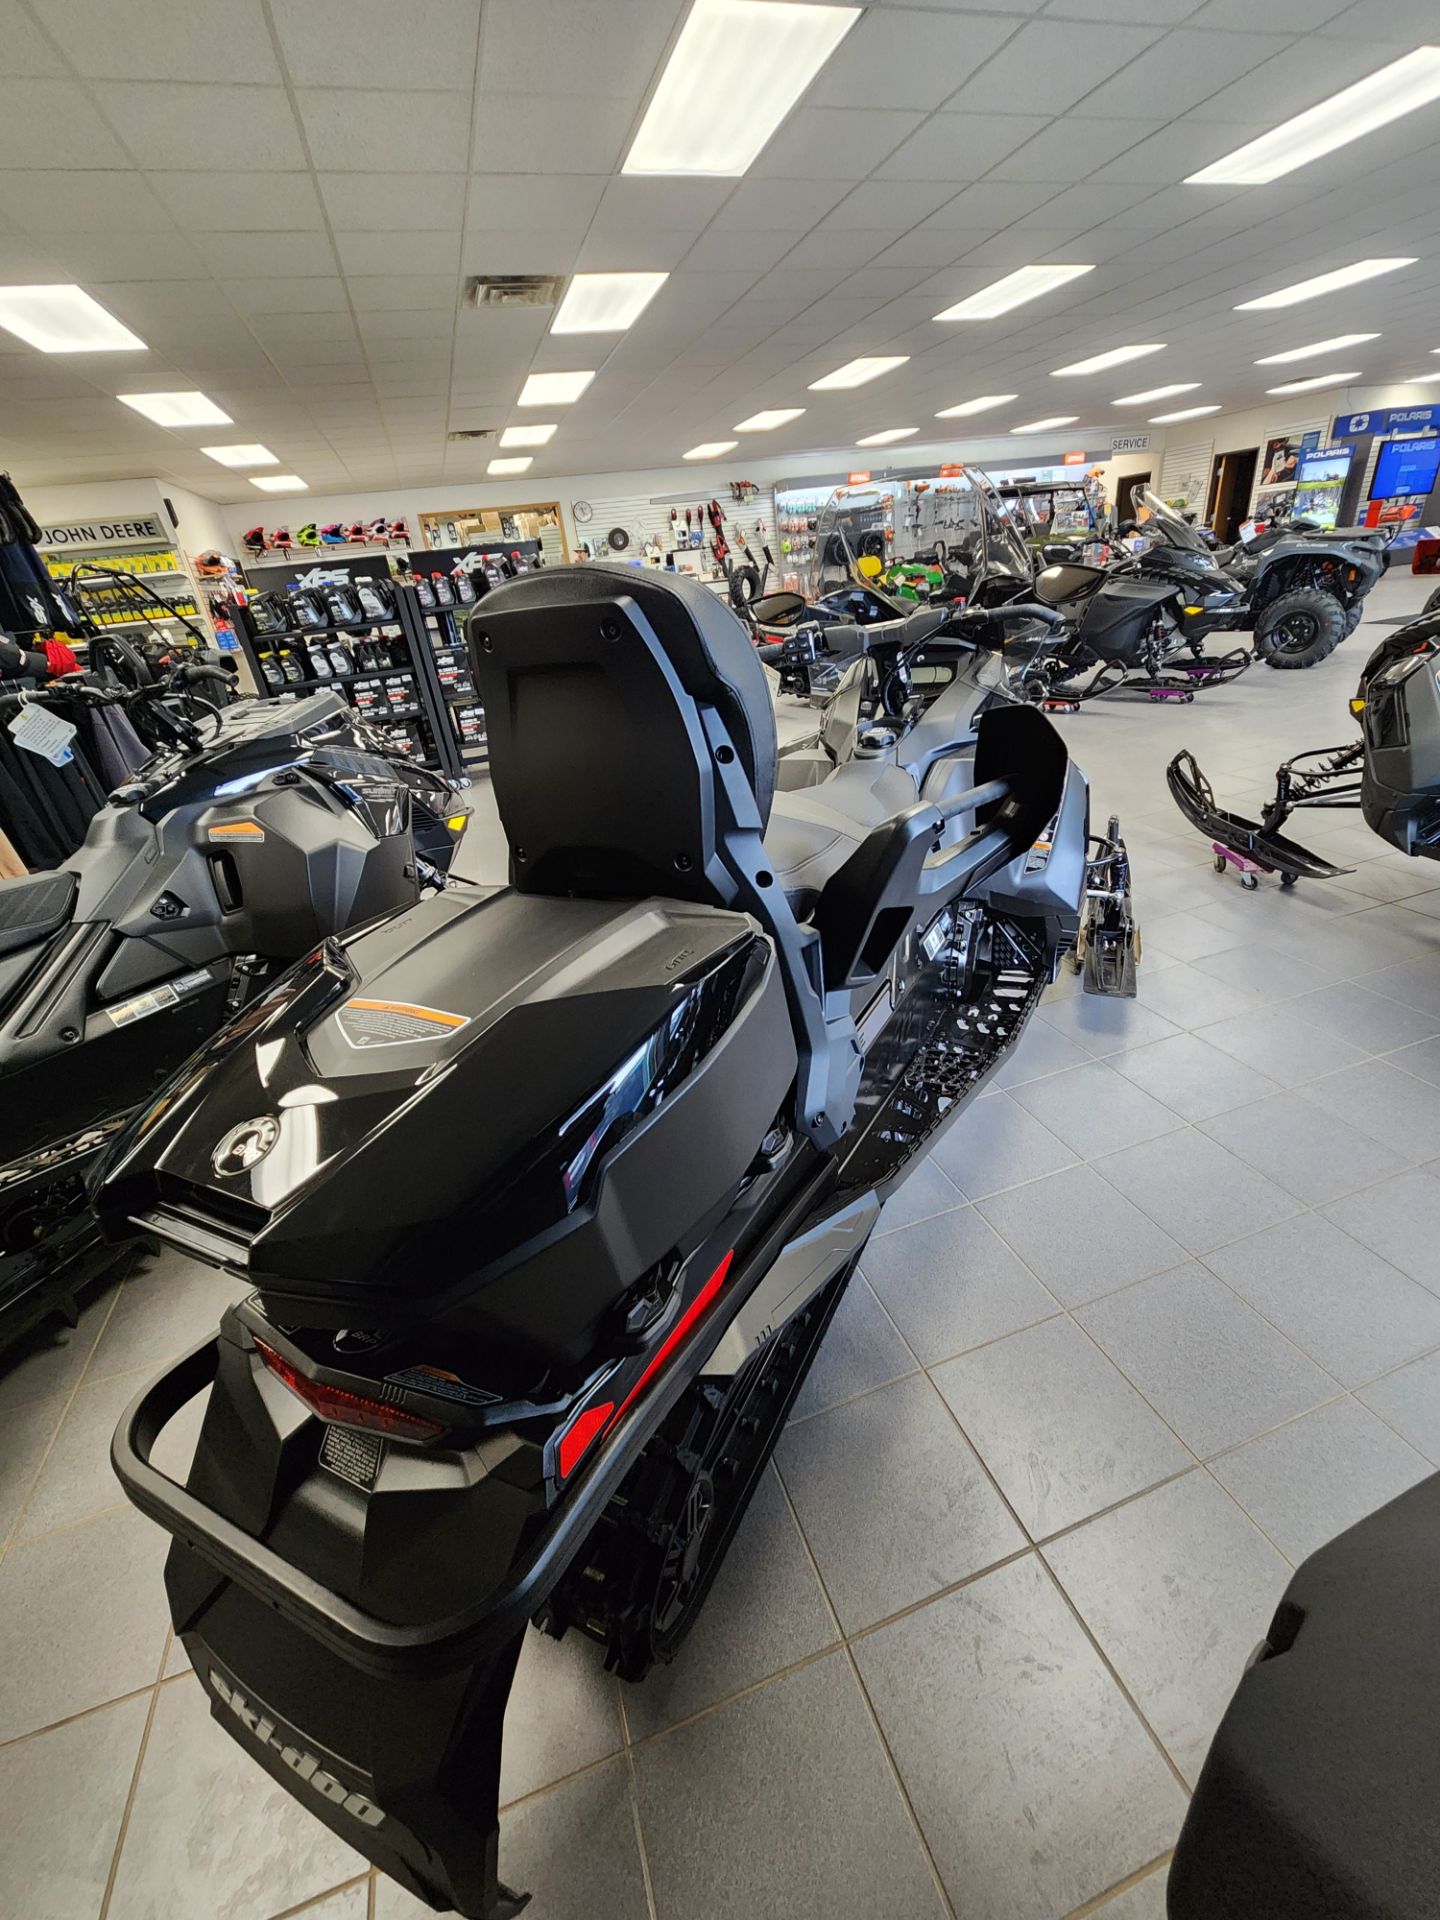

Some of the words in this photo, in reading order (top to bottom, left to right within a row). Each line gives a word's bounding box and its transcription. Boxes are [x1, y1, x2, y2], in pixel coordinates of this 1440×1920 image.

[1389, 410, 1432, 422] POLARIS
[1112, 437, 1148, 449] SERVICE
[1391, 441, 1436, 453] POLARIS
[1306, 448, 1350, 460] POLARIS
[45, 526, 97, 545] JOHN
[100, 521, 156, 540] DEERE
[295, 567, 350, 589] XPS
